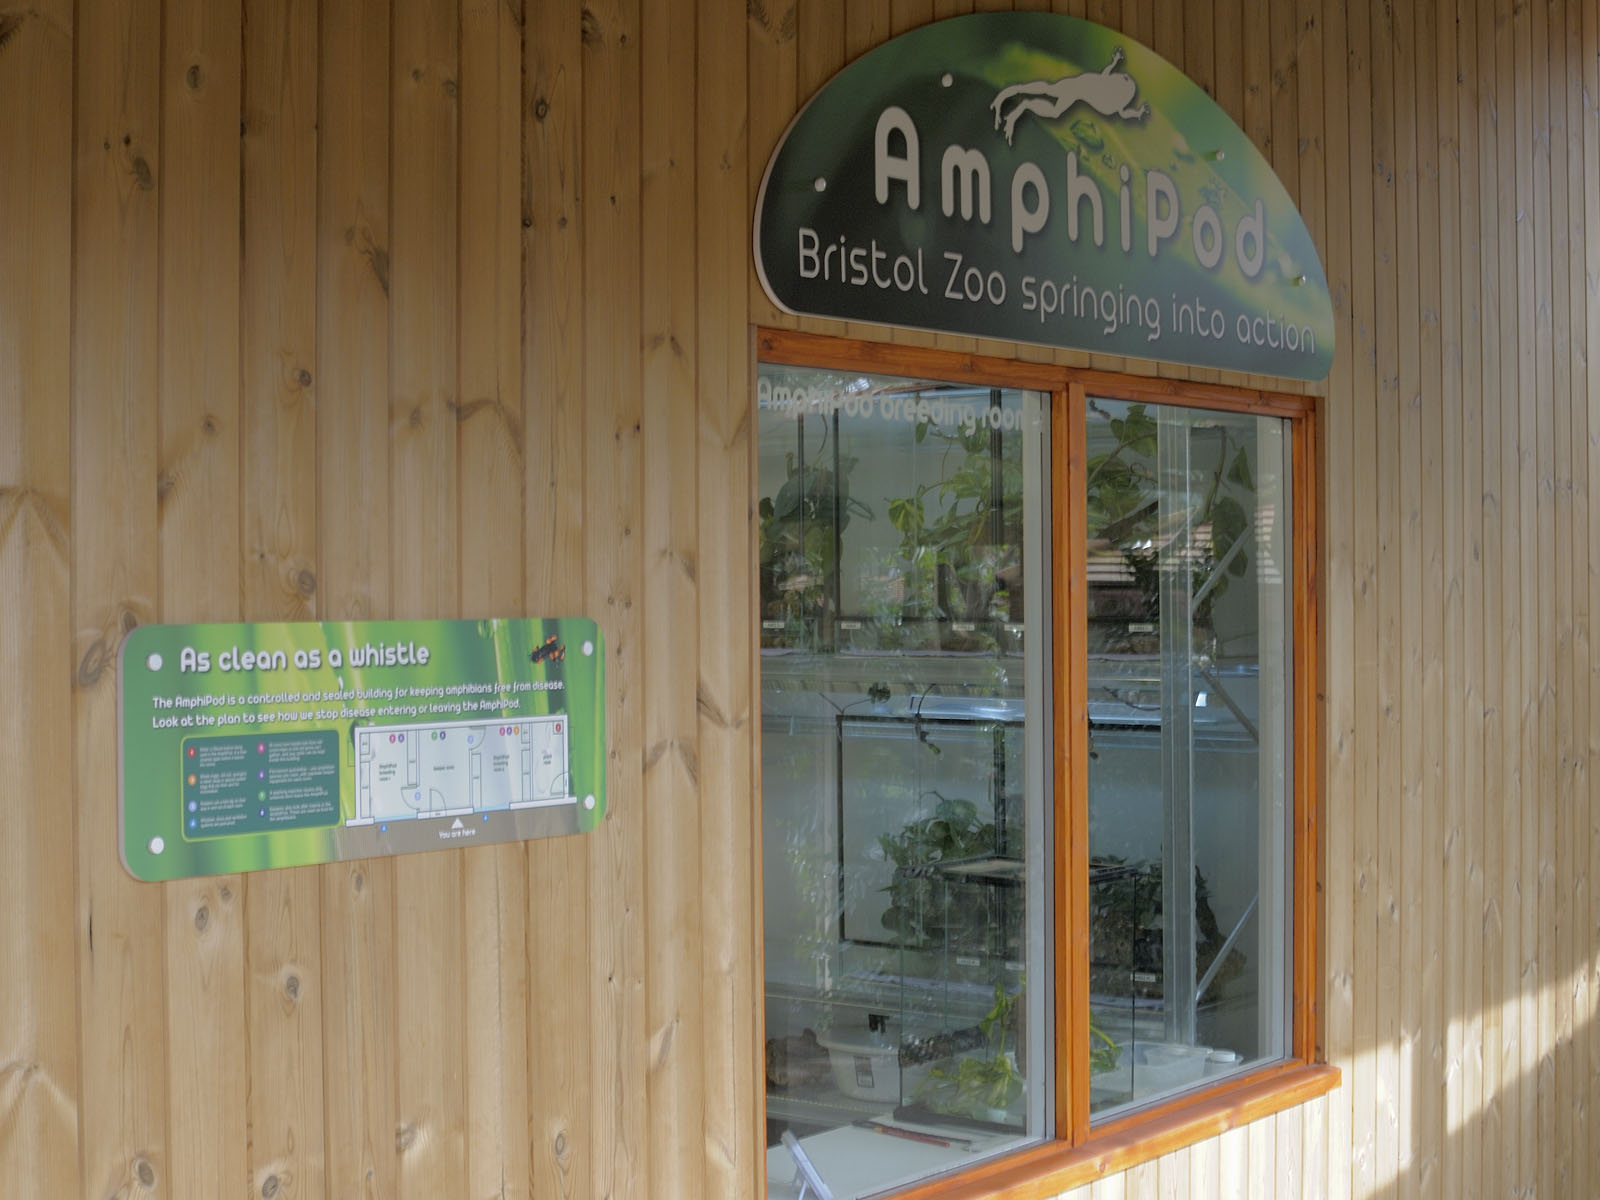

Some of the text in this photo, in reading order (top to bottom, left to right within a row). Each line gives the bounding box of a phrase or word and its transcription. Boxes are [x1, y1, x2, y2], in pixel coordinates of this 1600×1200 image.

[874, 106, 1266, 277] AmphiPod
[798, 227, 1316, 354] Bristol Zoo springing into action
[880, 393, 976, 438] breeding
[180, 643, 430, 672] As clean as a whistle
[153, 681, 565, 709] The AmphiPod is a controlled and sealed building for keeping amphibians free from disease.
[153, 716, 178, 728] Look
[181, 716, 194, 726] at
[196, 714, 215, 726] the
[218, 714, 240, 727] plan
[243, 713, 255, 723] to
[257, 713, 275, 723] see
[278, 711, 298, 721] how
[300, 711, 313, 720] we
[315, 709, 338, 720] stop
[341, 707, 375, 718] disease
[378, 704, 417, 717] entering
[418, 705, 428, 714] or
[430, 703, 461, 714] leaving
[462, 702, 478, 711] the
[439, 831, 450, 839] You
[462, 828, 476, 837] here
